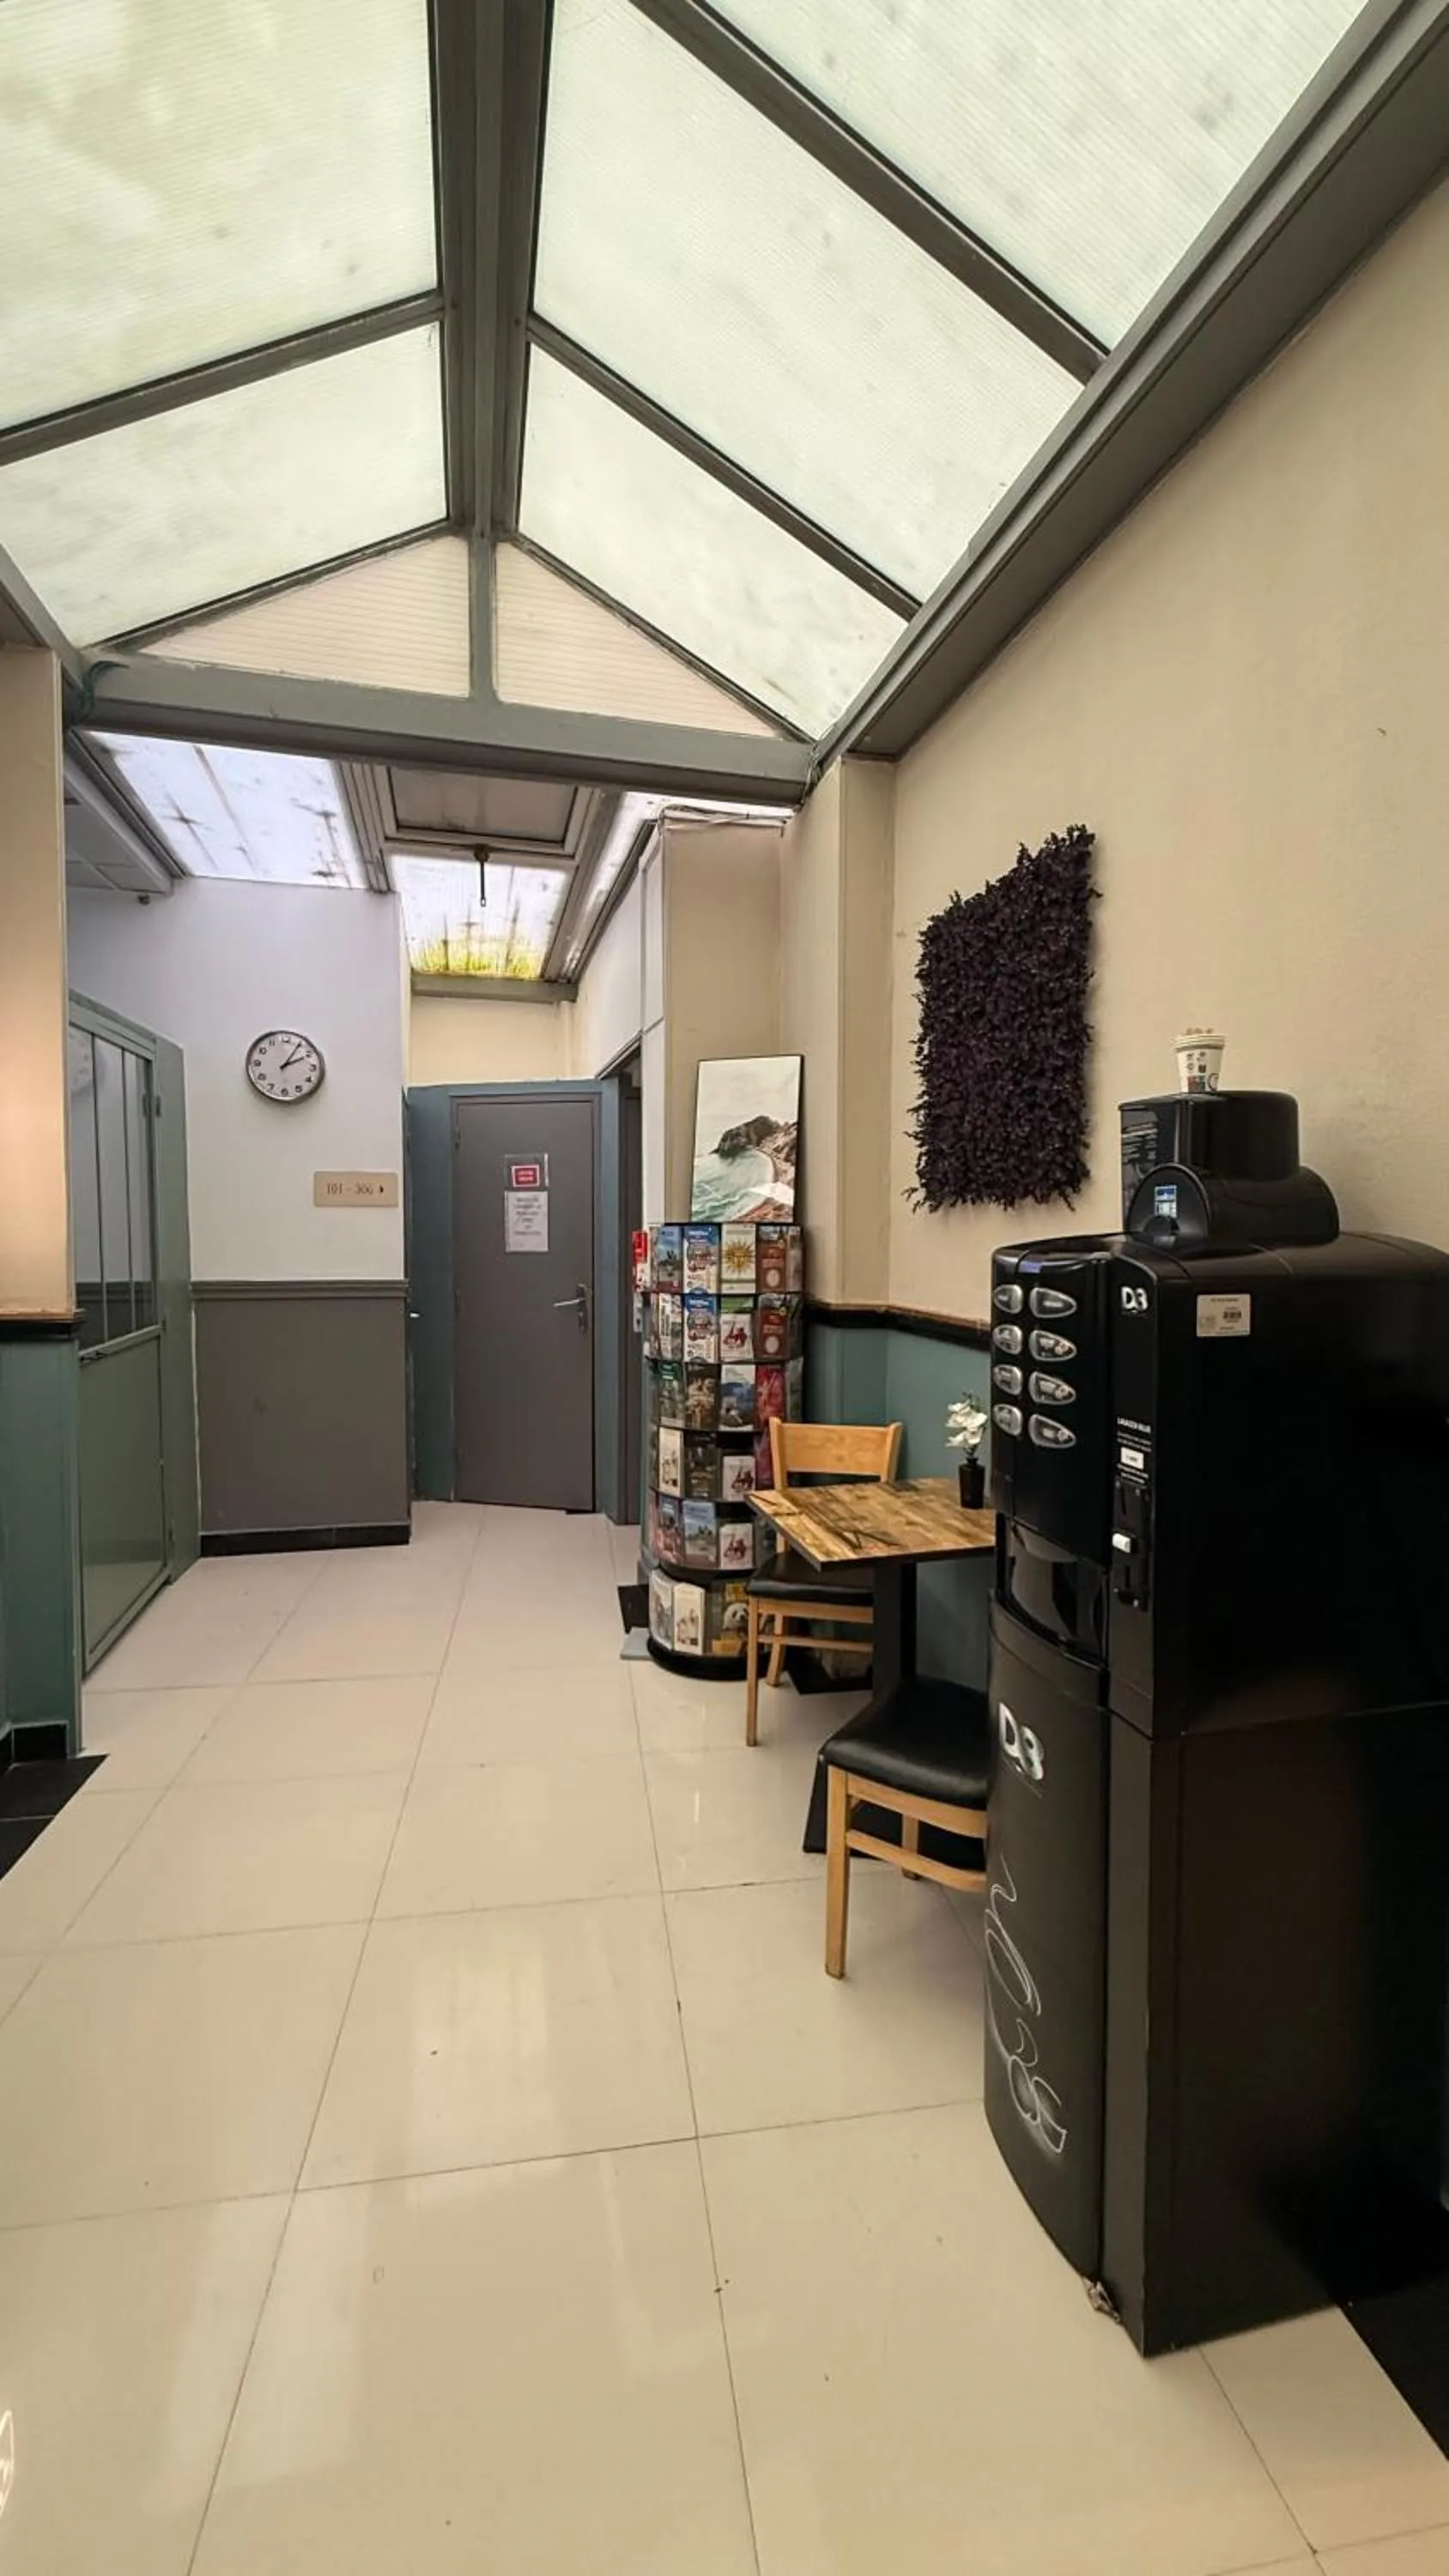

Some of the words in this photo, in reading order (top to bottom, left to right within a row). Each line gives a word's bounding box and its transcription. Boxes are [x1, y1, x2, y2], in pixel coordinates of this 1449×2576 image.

[258, 1047, 267, 1055] 10
[267, 1083, 275, 1091] 7
[294, 1084, 303, 1093] 5
[281, 1088, 289, 1097] 6
[326, 1182, 343, 1195] 101
